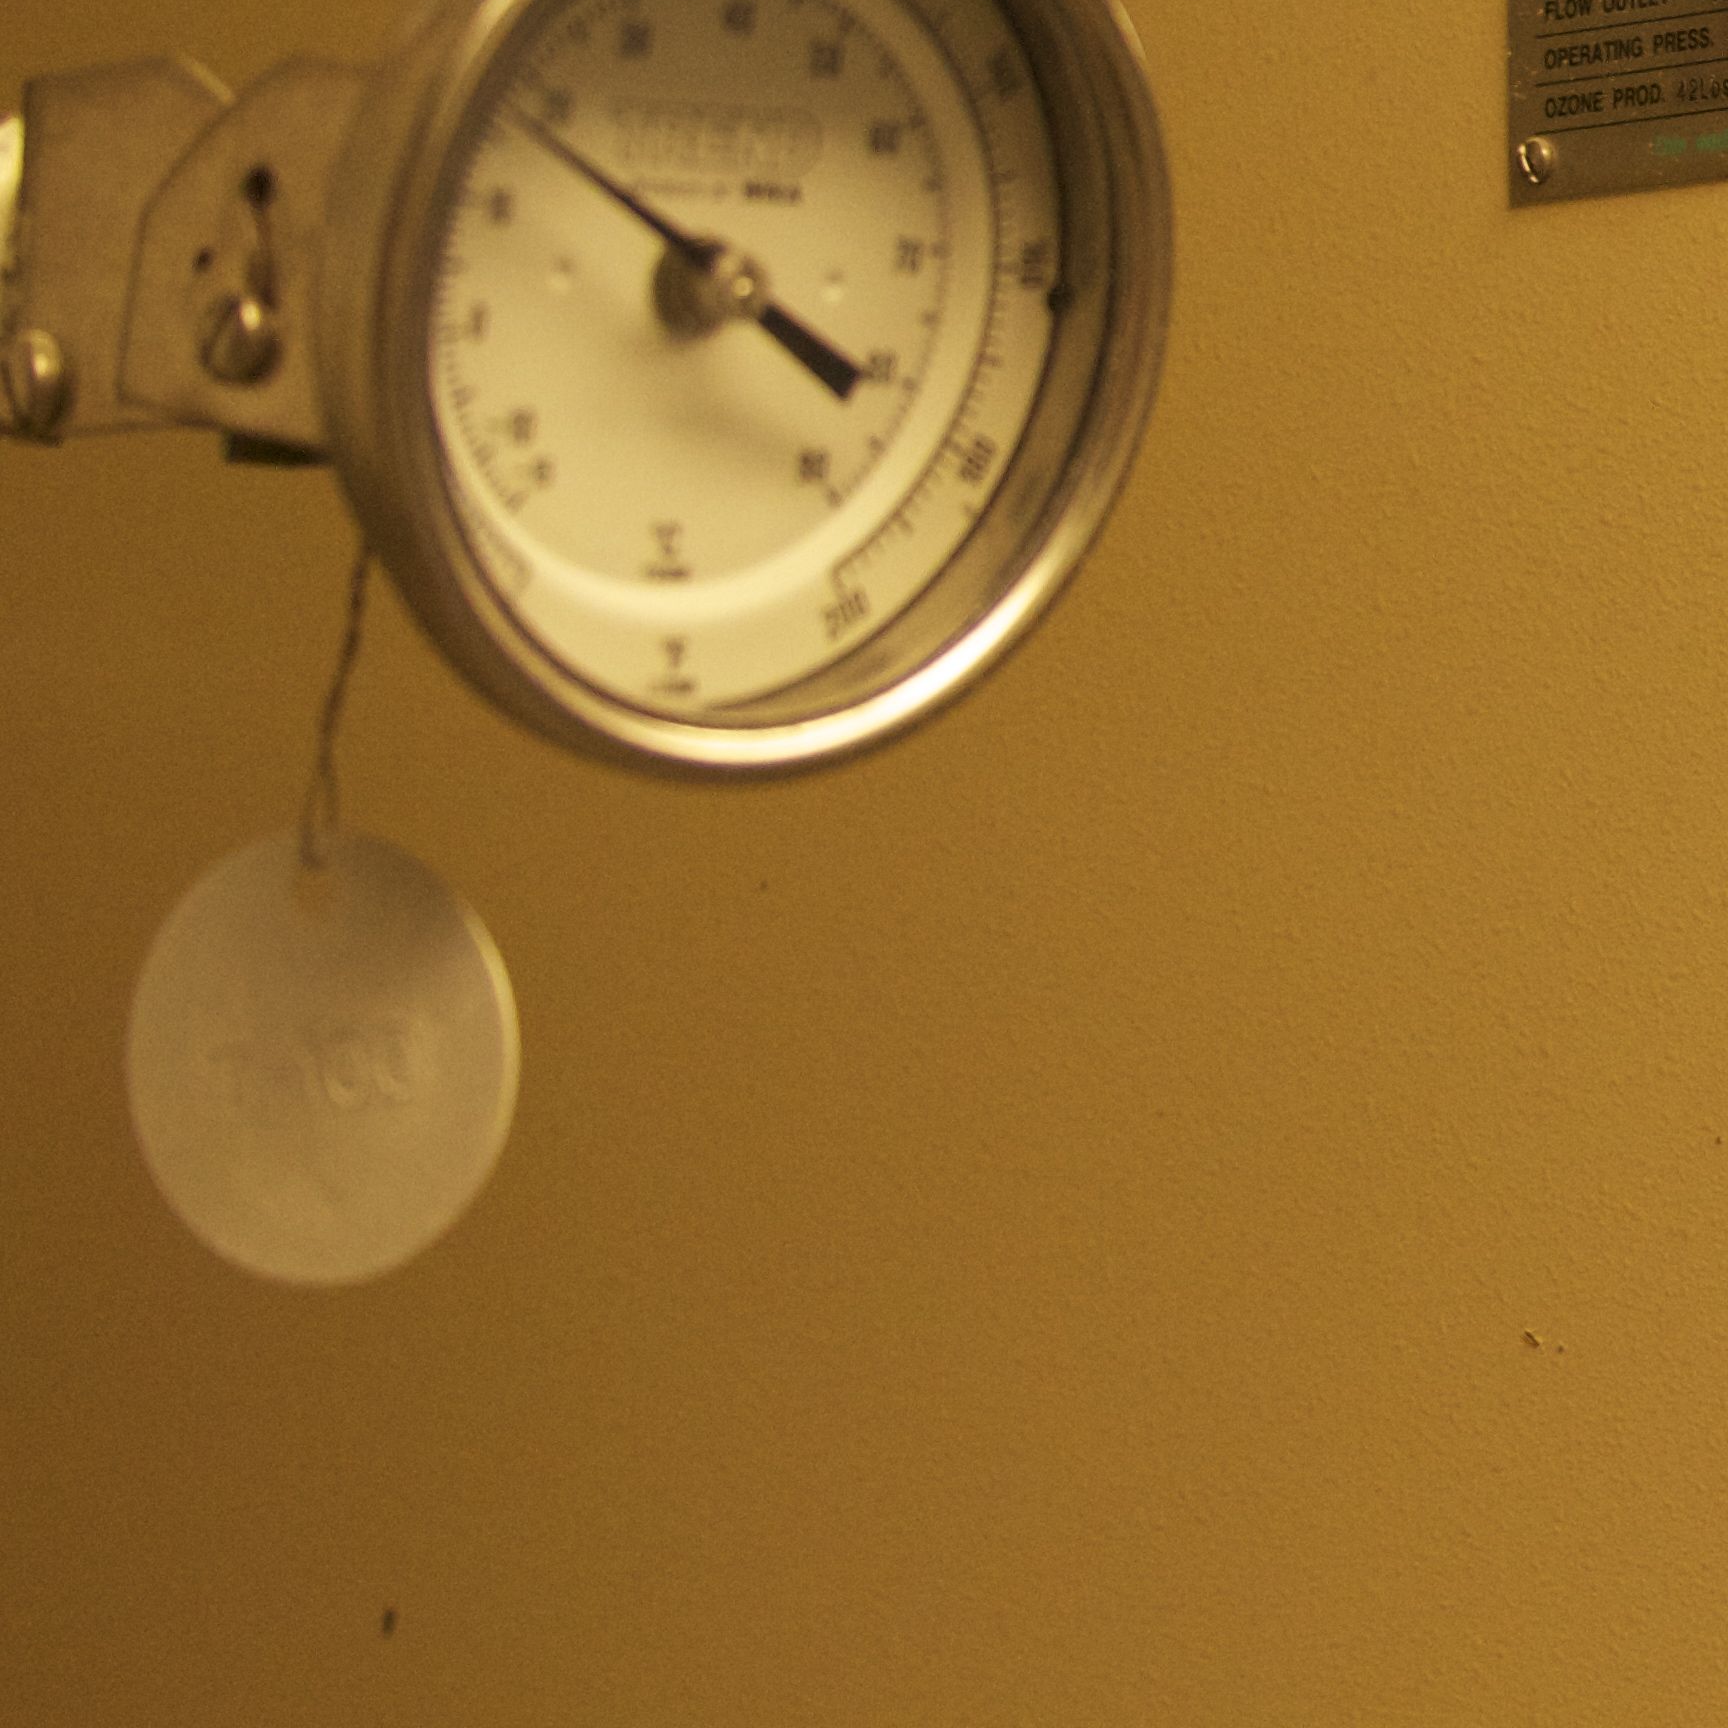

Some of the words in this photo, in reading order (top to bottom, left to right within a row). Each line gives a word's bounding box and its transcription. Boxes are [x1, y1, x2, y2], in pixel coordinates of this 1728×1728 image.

[1544, 36, 1643, 70] OPERATING
[1653, 26, 1714, 56] PRESS.
[1544, 90, 1604, 120] OZONE
[1612, 83, 1666, 109] PROD.
